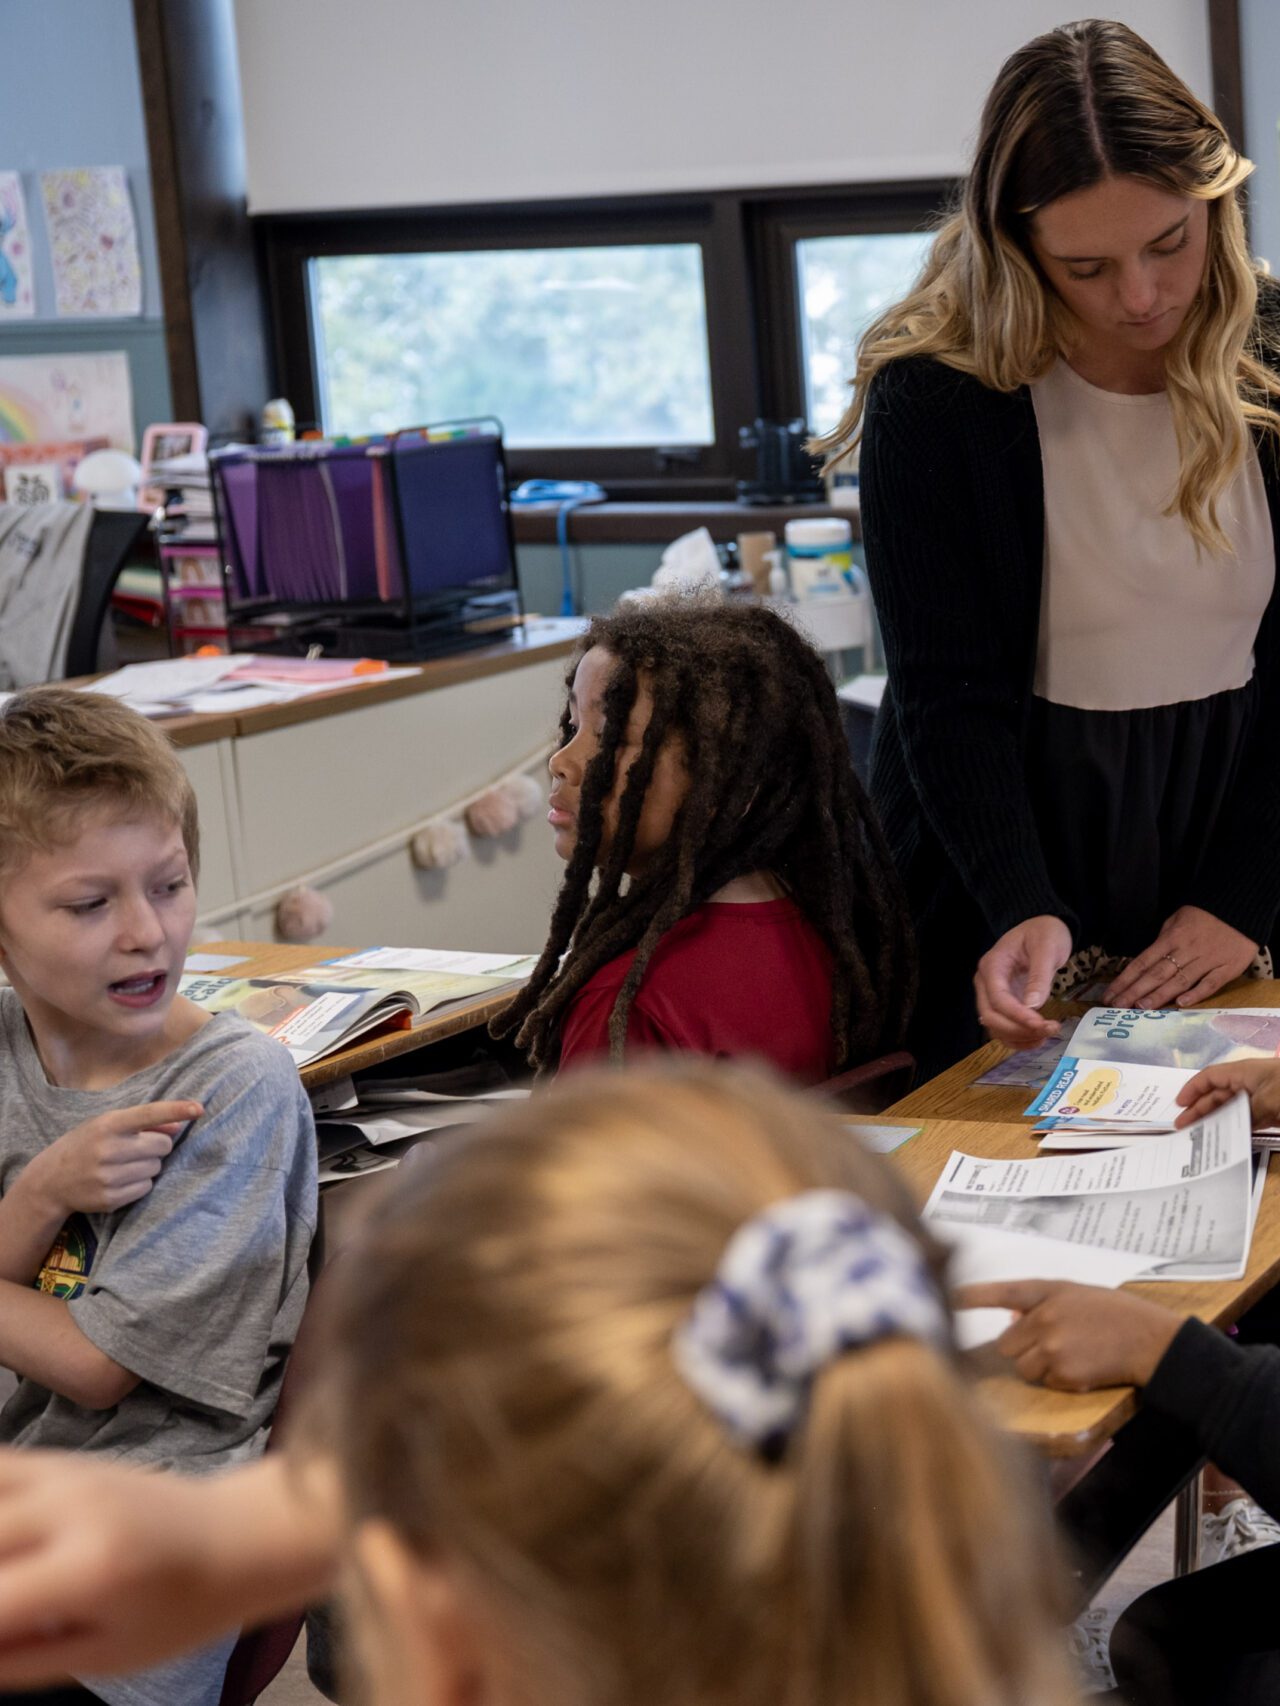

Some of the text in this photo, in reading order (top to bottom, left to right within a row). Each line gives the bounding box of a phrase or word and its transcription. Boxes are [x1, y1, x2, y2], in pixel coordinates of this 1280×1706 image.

[1093, 1008, 1122, 1027] The
[1038, 1089, 1063, 1112] SHARED
[1056, 1071, 1075, 1090] READ
